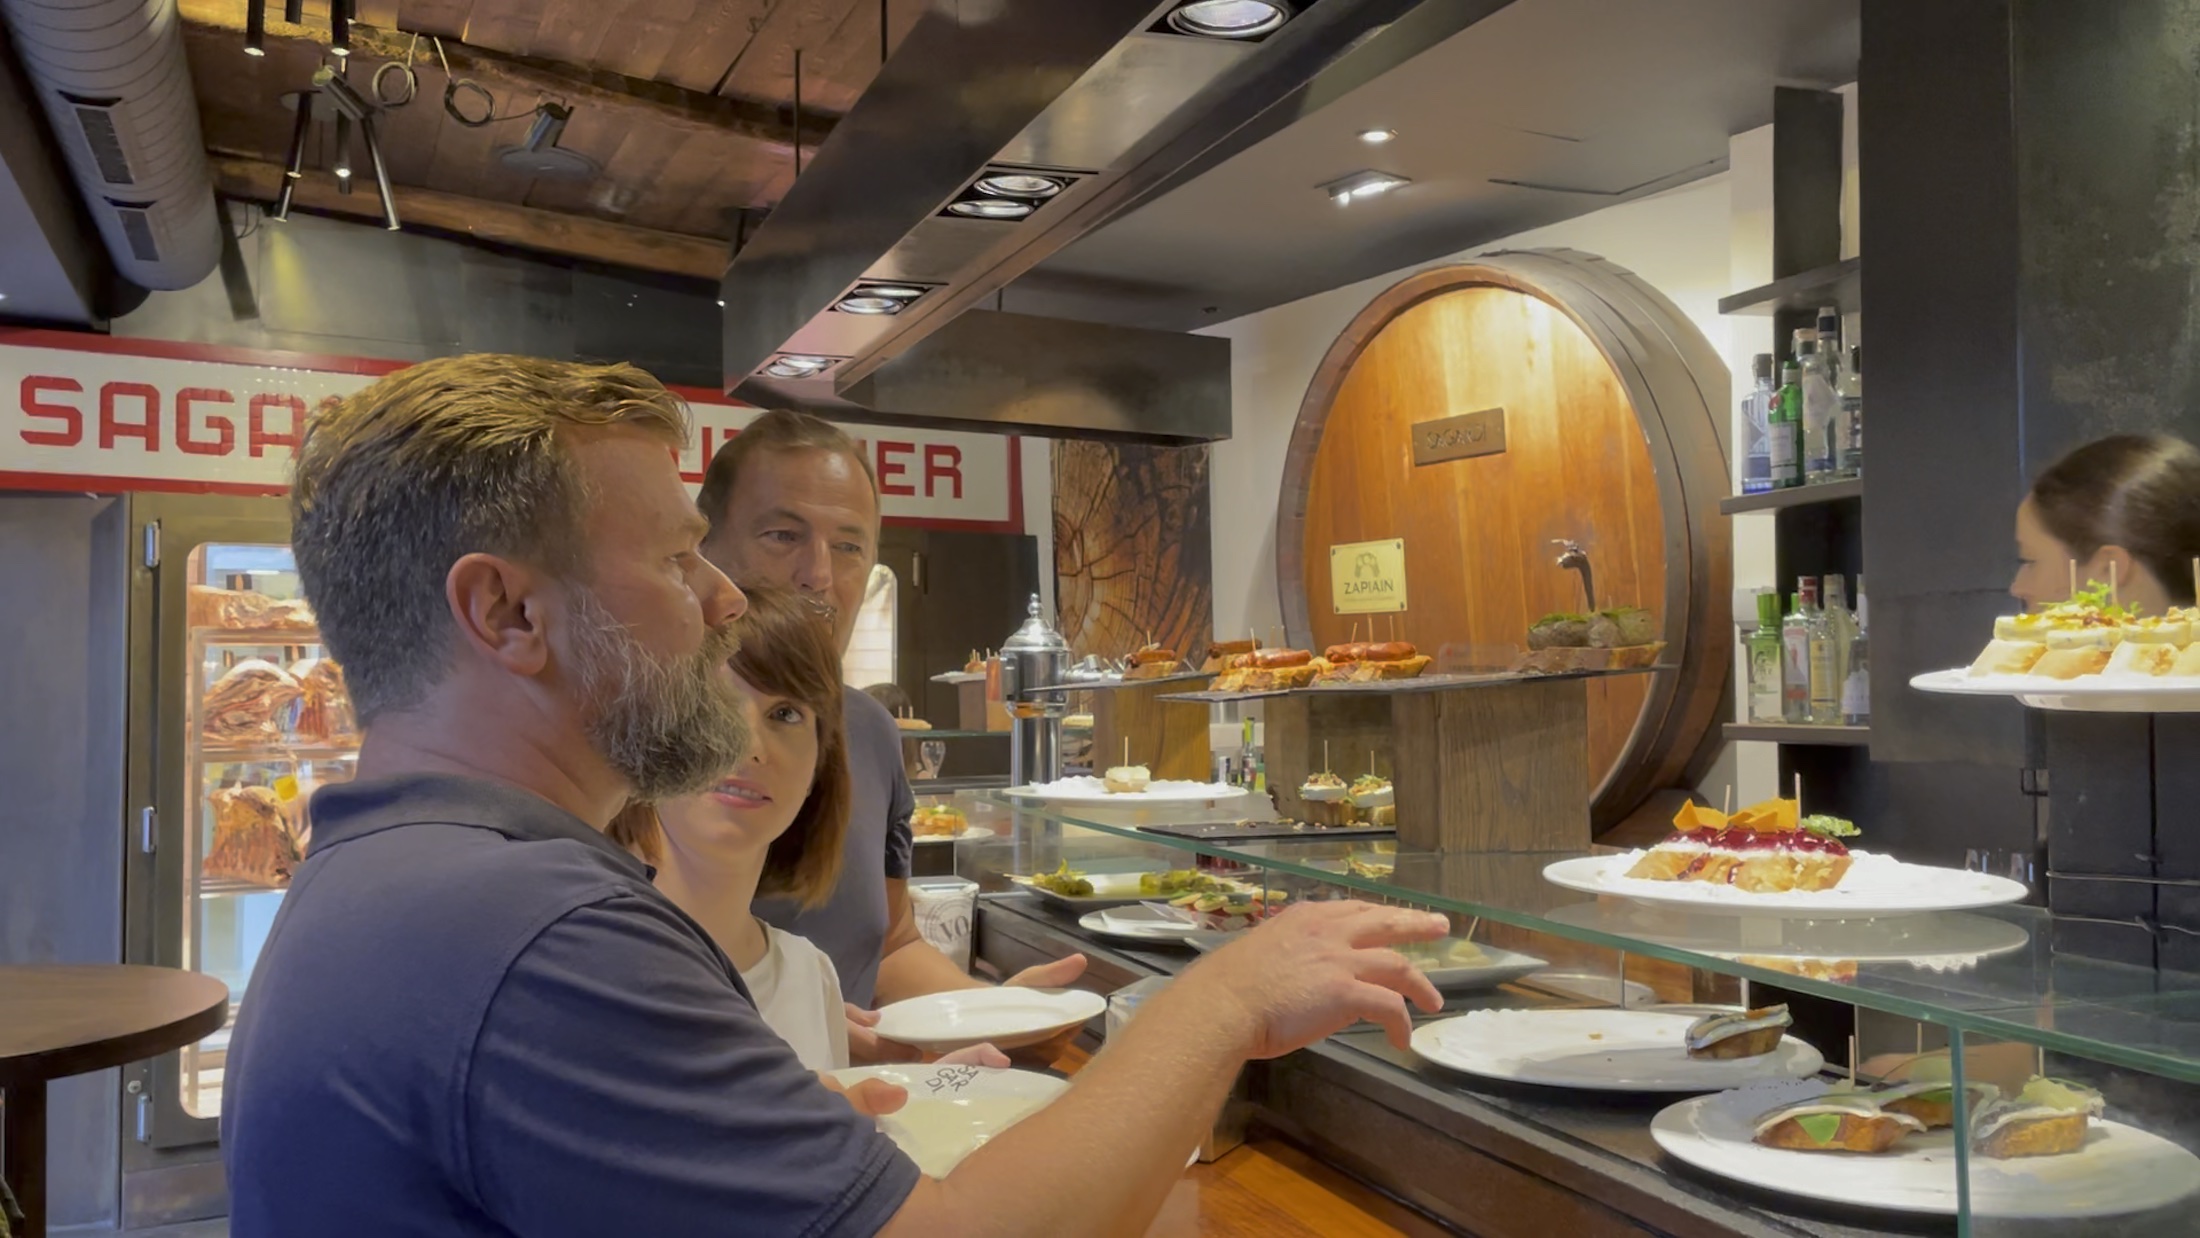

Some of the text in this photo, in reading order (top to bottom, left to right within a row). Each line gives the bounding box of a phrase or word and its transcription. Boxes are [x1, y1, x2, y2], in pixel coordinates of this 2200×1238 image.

[20, 374, 341, 459] SAGA
[1343, 579, 1394, 595] ZAPIAIN
[924, 1077, 945, 1093] DI
[936, 1067, 969, 1092] GAR
